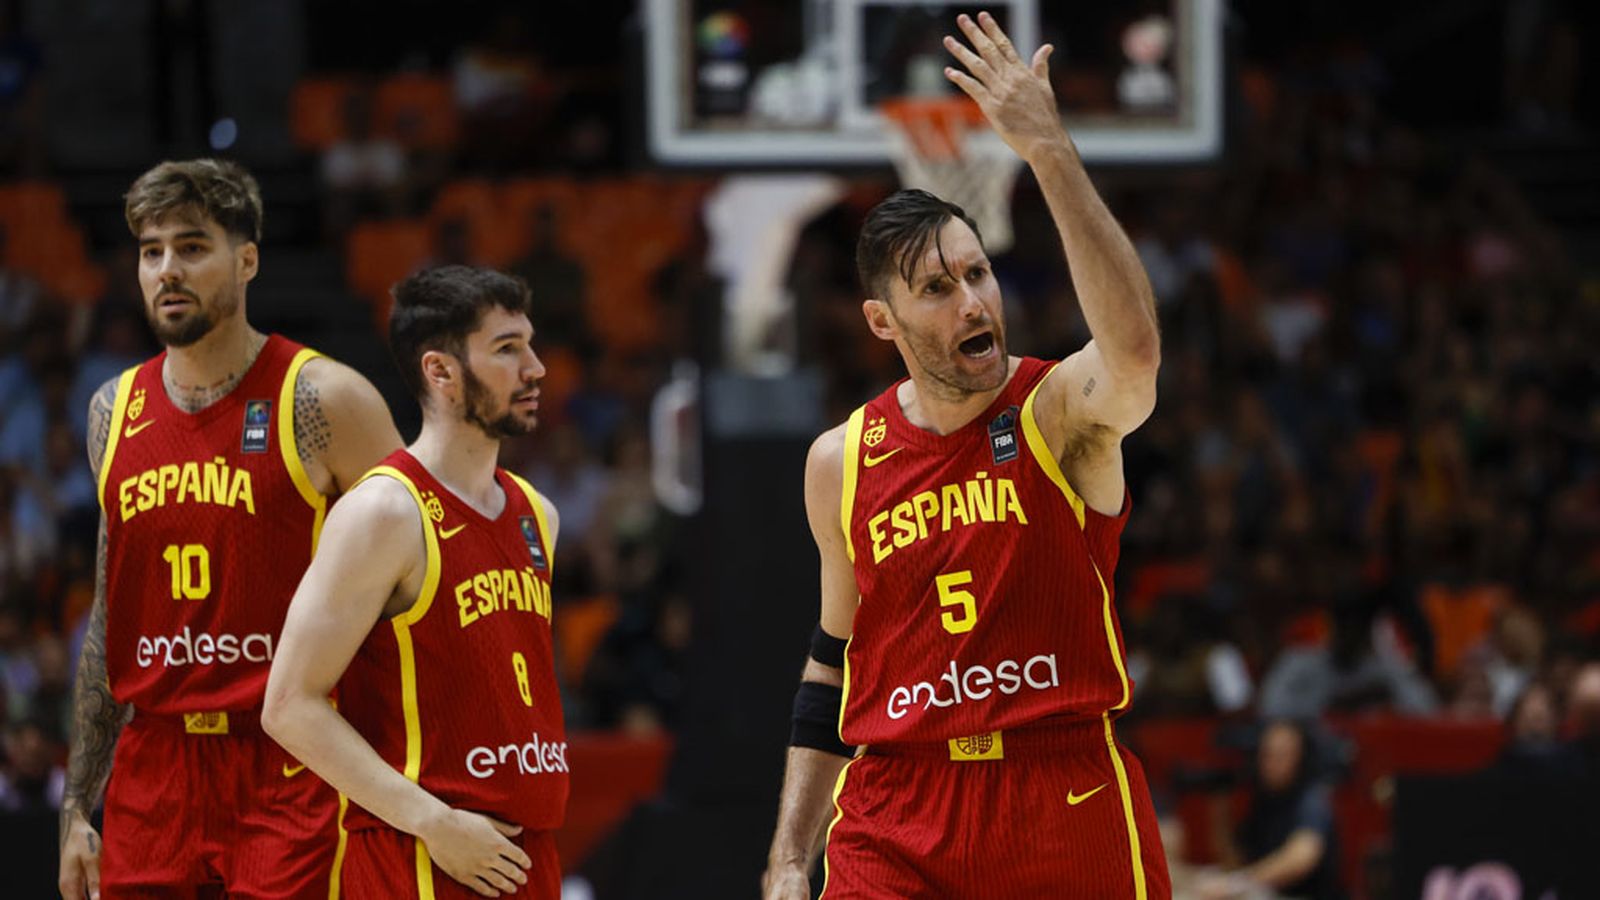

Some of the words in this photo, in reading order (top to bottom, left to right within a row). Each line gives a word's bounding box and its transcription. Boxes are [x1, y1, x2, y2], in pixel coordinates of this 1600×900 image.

[119, 456, 256, 523] ESPAÑA
[867, 471, 1029, 564] ESPAÑA
[162, 544, 211, 600] 10
[935, 570, 978, 635] 5
[136, 626, 273, 668] endesa
[512, 651, 533, 707] 8
[887, 653, 1060, 719] endesa
